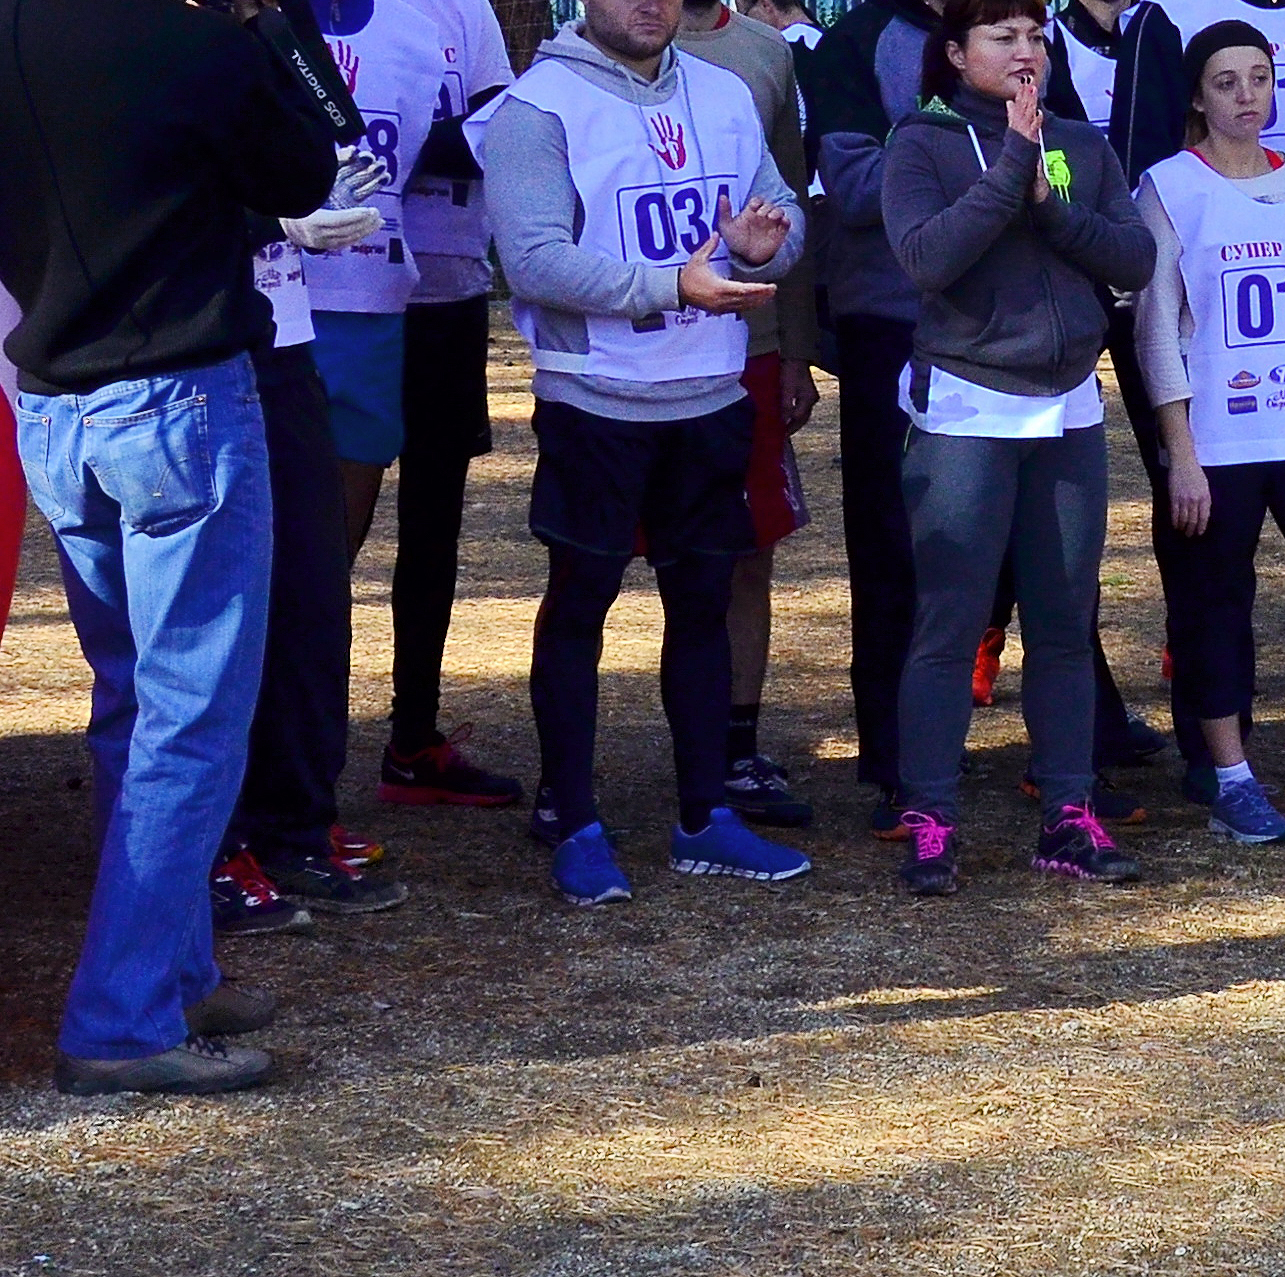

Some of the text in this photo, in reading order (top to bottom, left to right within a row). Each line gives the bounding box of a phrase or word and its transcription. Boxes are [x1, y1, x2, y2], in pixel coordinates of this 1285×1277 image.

[291, 49, 346, 127] EOS DIGITAL
[1221, 242, 1282, 261] СУПЕР
